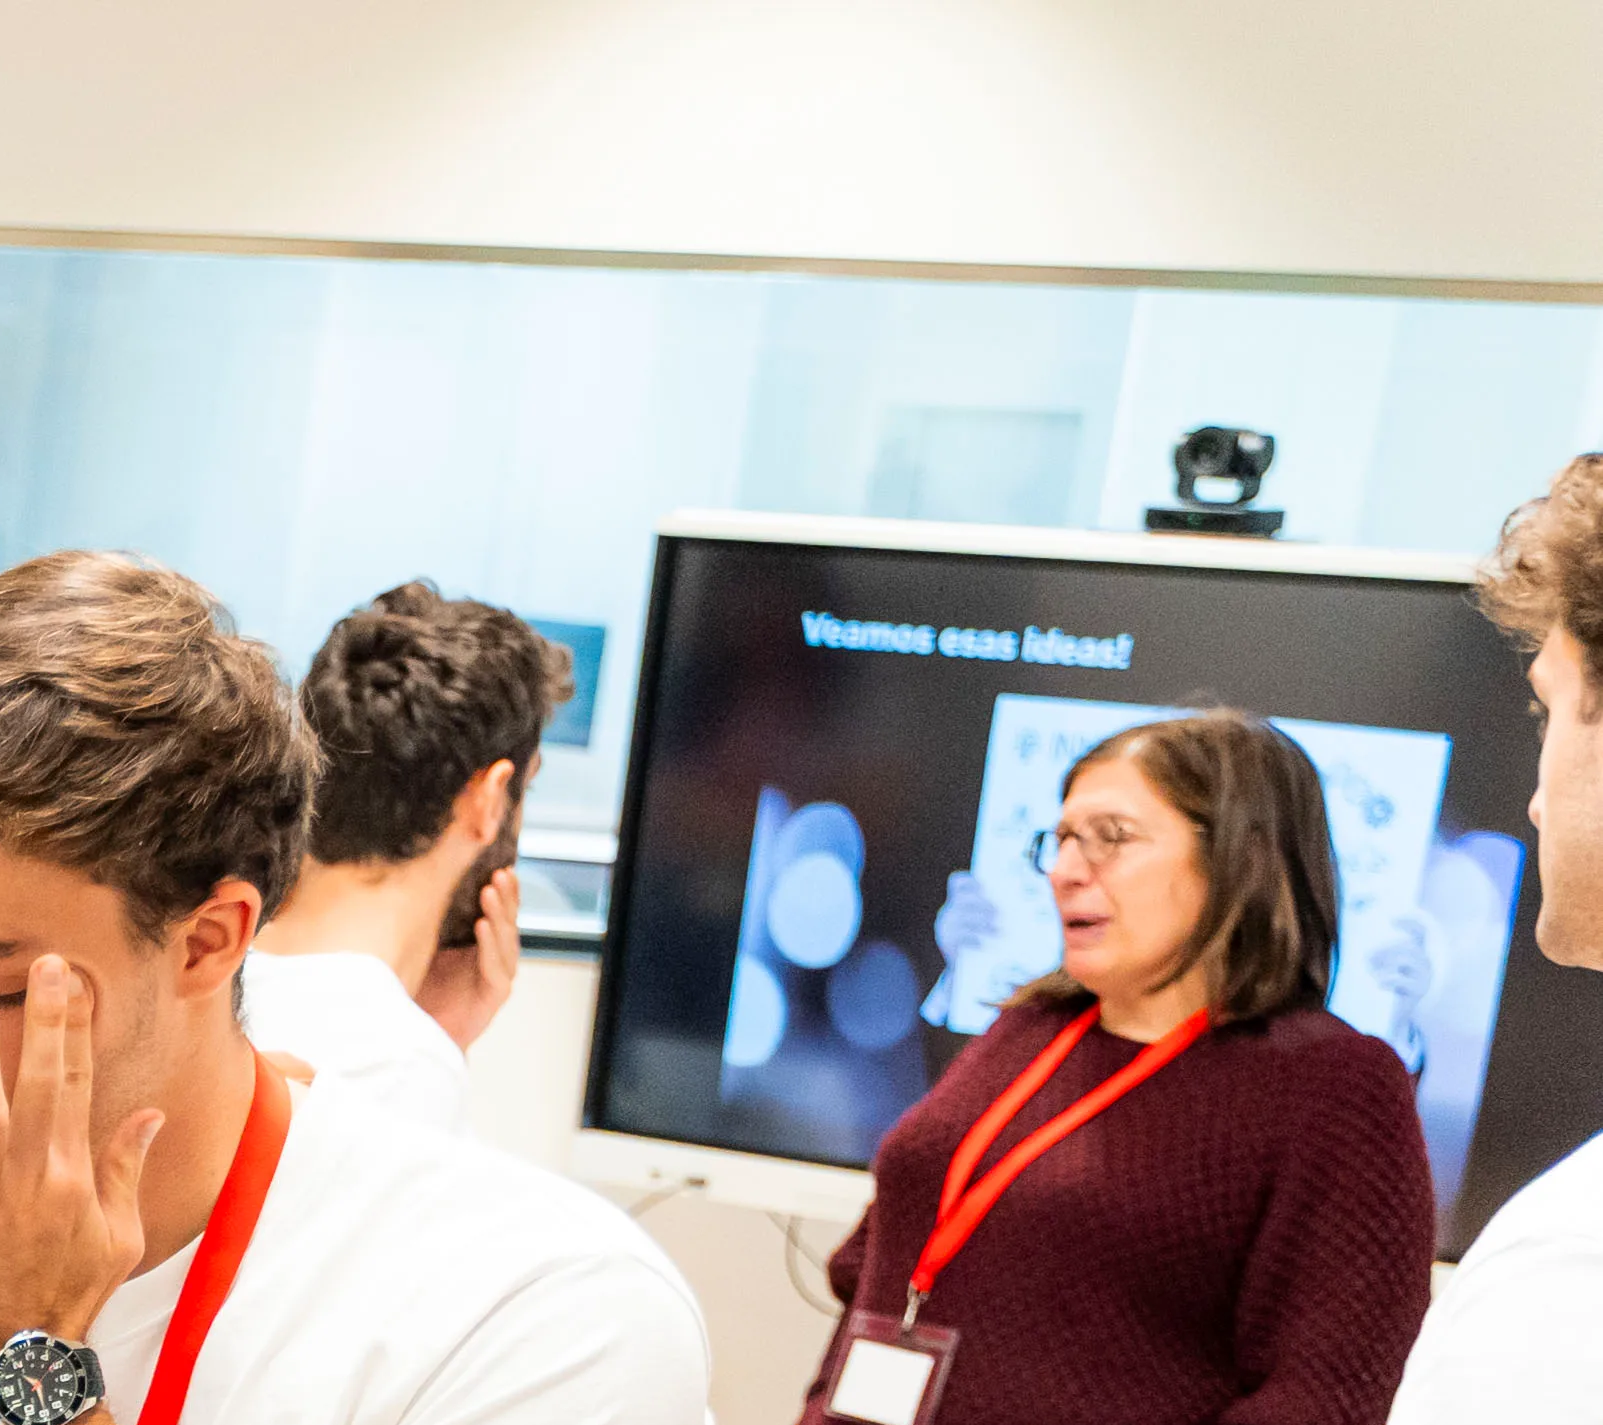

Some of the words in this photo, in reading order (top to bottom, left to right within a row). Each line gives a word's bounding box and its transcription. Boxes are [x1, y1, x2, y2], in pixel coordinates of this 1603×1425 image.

[801, 611, 937, 656] Veamos
[938, 627, 1020, 662] esas
[1021, 625, 1134, 670] ideas!
